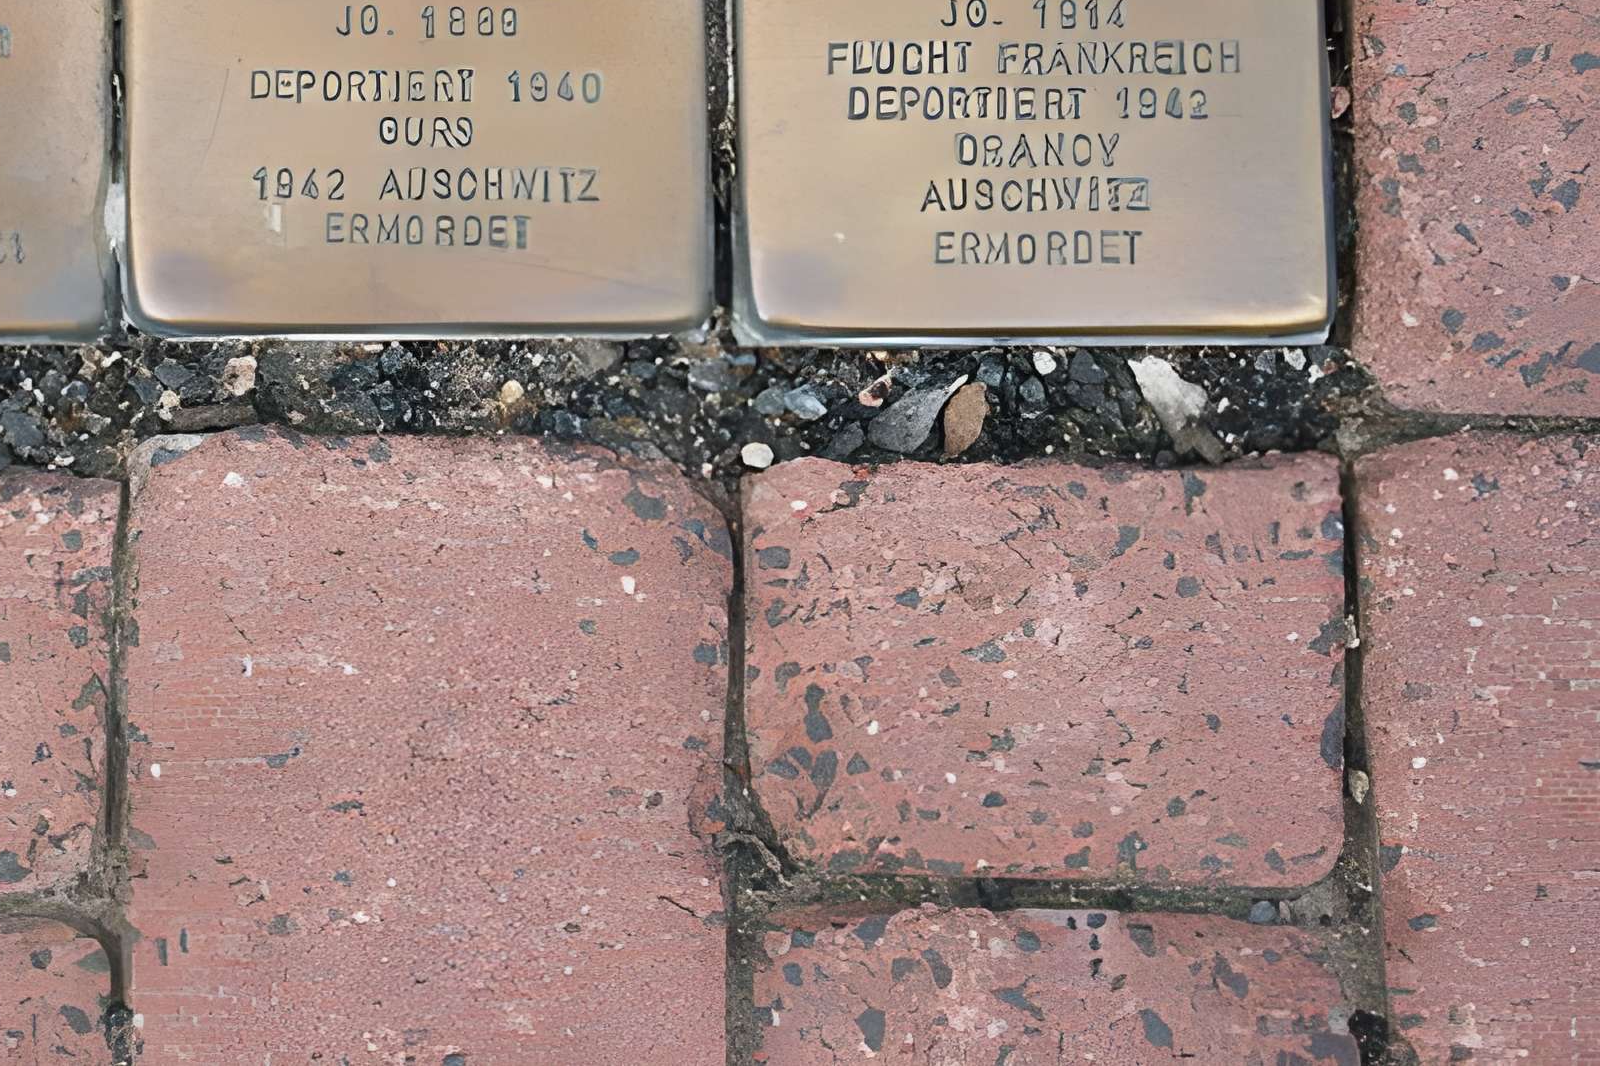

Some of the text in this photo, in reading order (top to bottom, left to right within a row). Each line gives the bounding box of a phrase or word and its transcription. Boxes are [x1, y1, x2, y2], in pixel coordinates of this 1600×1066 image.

[827, 40, 1240, 75] FLUCHT FRANKREICH
[251, 69, 602, 103] DEPORTIERT 1940
[848, 86, 1086, 120] DEPORTIERT
[252, 166, 600, 202] 1942 AUSCHWITZ
[920, 176, 1150, 212] AUSCHWITZ
[326, 213, 531, 249] ERMORDET
[935, 230, 1142, 266] ERMORDET
